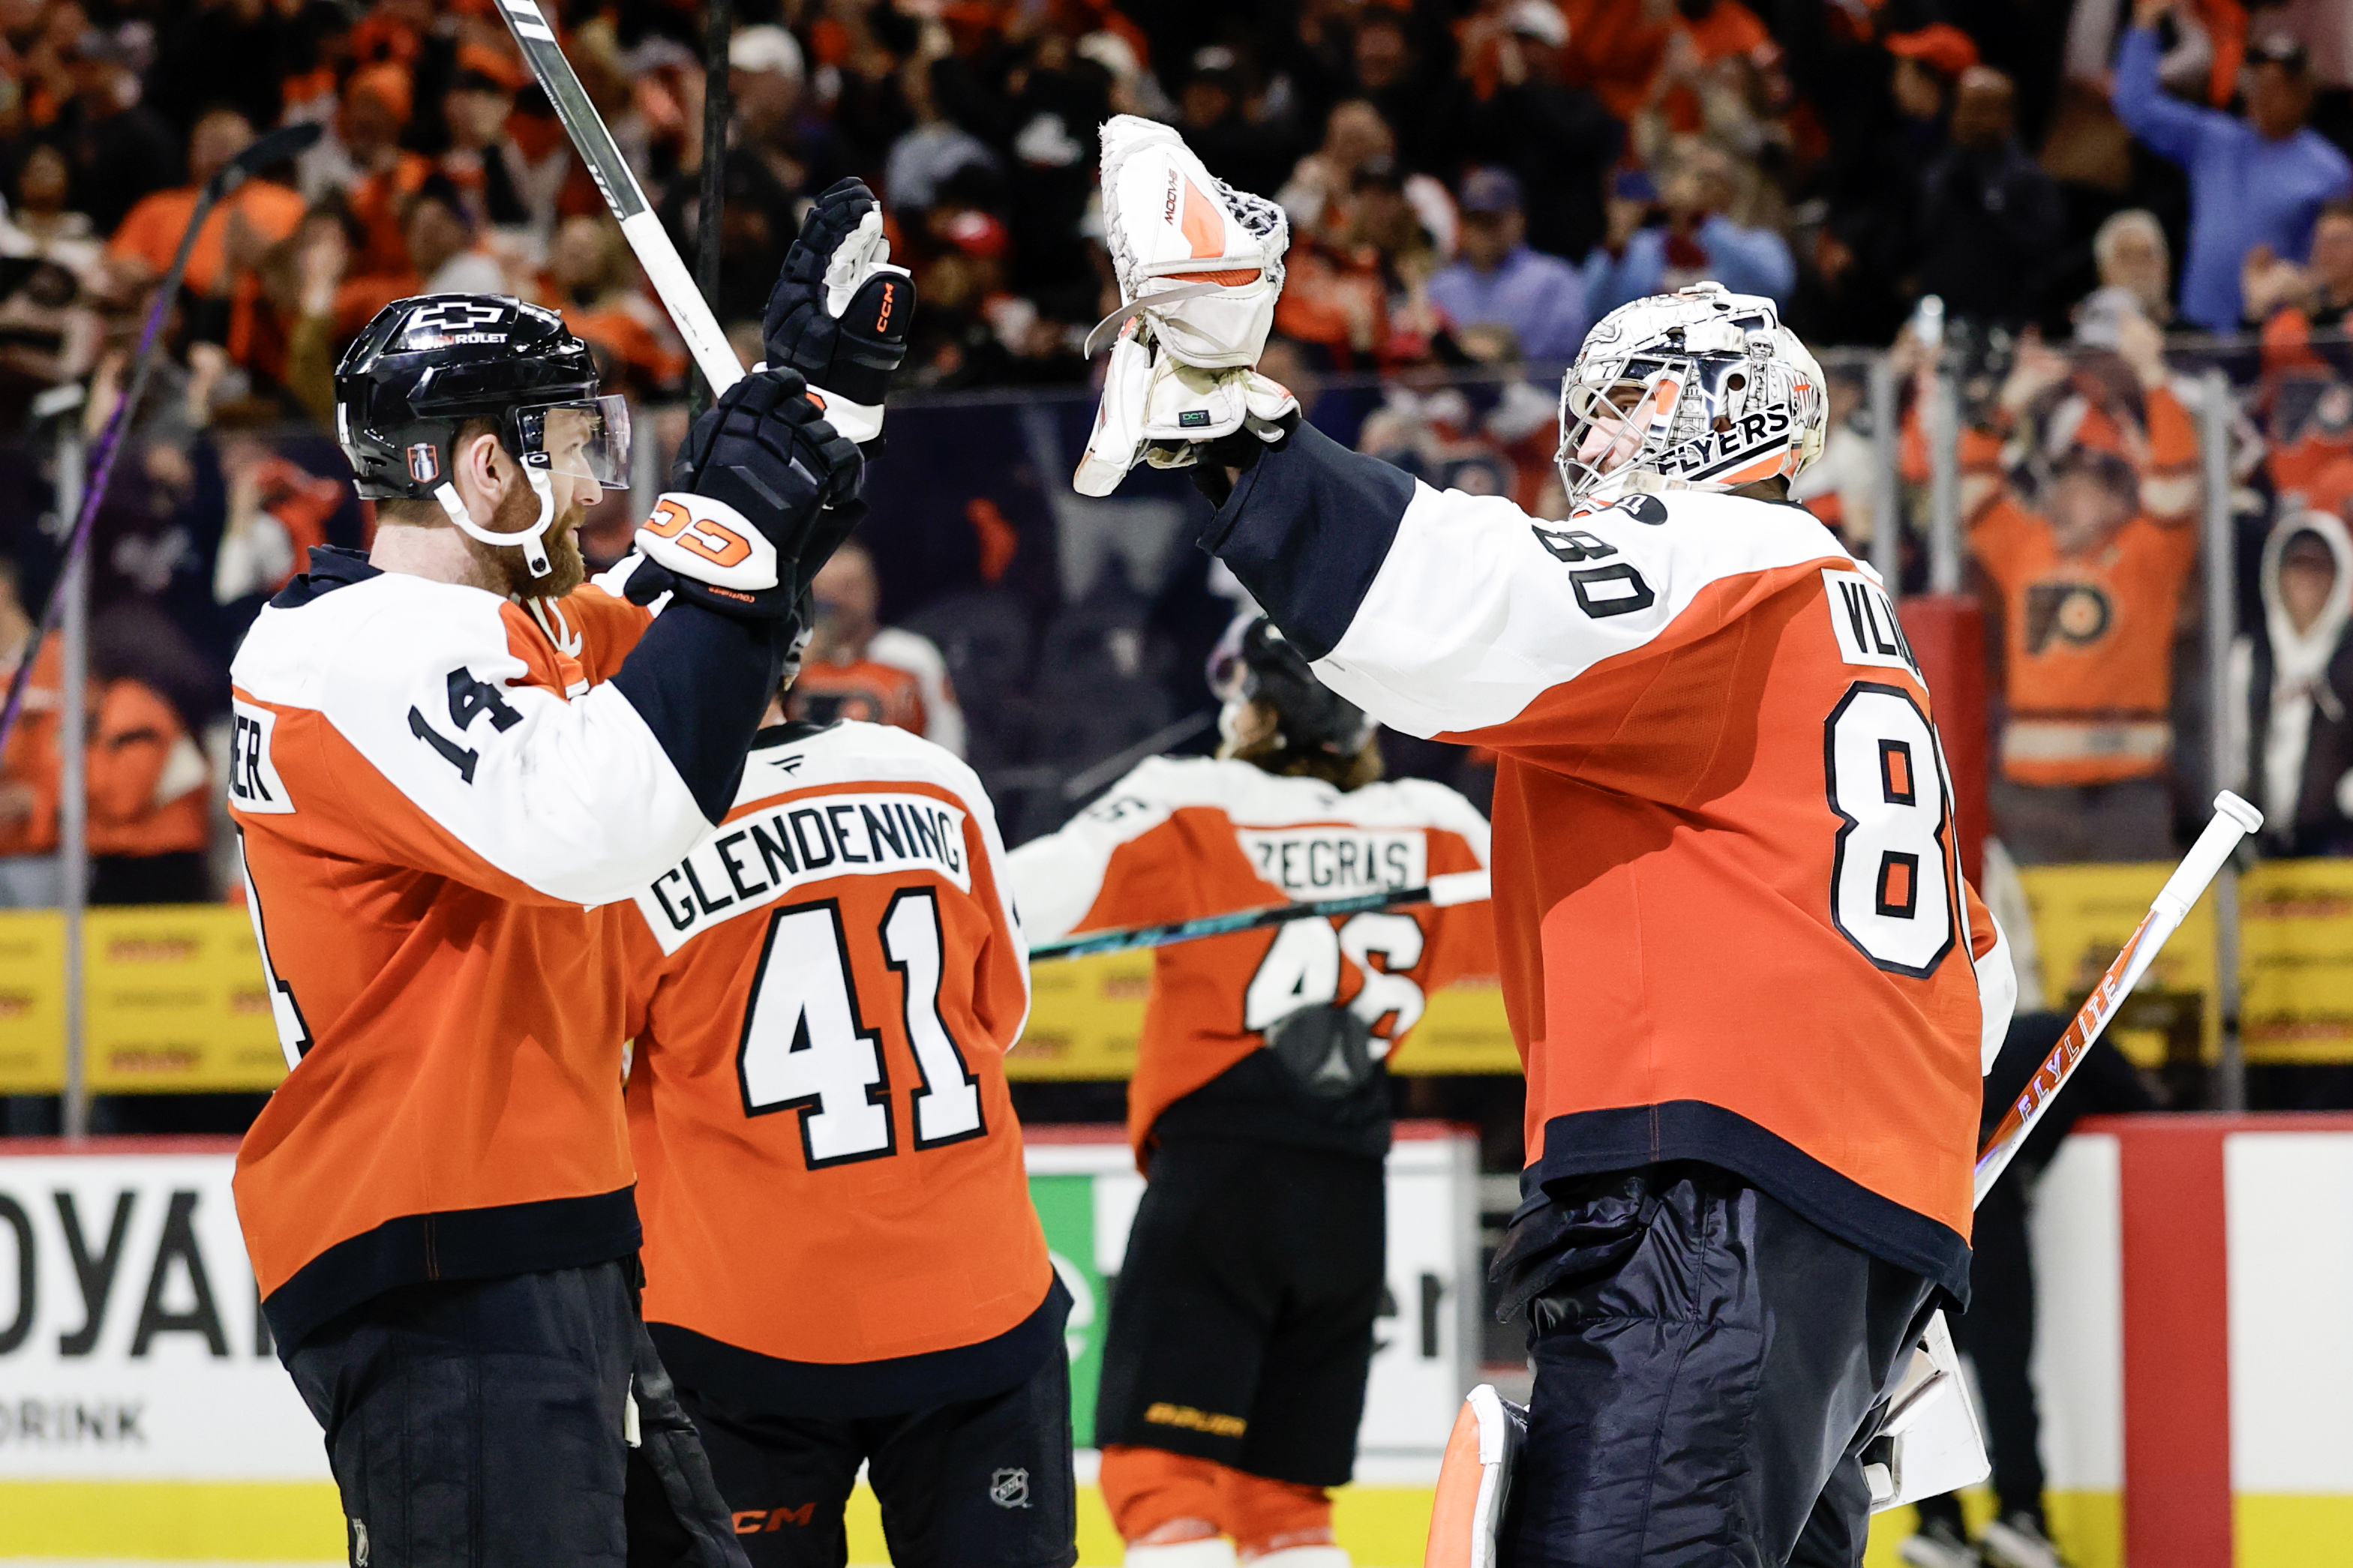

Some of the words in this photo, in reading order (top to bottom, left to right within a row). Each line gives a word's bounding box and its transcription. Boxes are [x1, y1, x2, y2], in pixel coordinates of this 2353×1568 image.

[1164, 168, 1178, 226] SHADOW
[877, 282, 894, 333] CCM
[1658, 402, 1790, 478] FLYERS
[1531, 524, 1655, 619] 80
[407, 666, 524, 785] 14
[651, 802, 962, 932] GLENDENING
[736, 885, 989, 1171] 41
[2017, 974, 2119, 1126] FLYLITE
[0, 1399, 147, 1443] RINK
